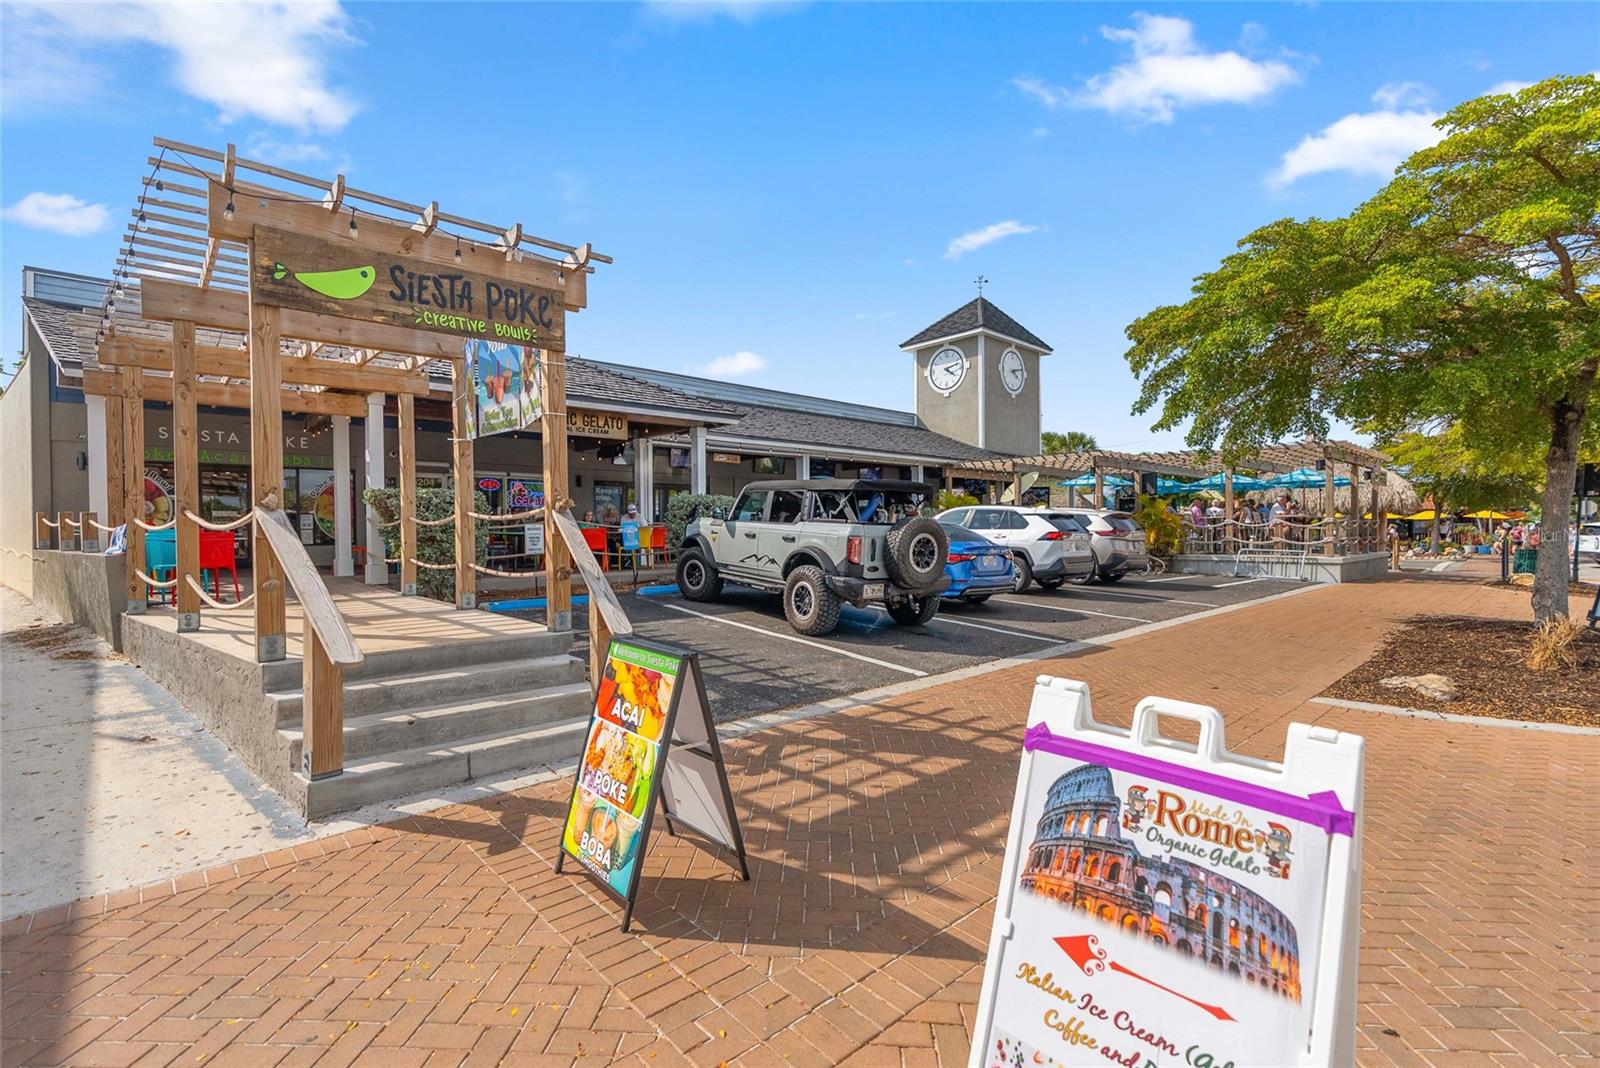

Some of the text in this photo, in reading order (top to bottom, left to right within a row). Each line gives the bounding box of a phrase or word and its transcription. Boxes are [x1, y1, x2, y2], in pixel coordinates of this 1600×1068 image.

[583, 415, 623, 431] GELATO
[158, 426, 310, 449] SSTA KE
[144, 448, 174, 461] oke
[284, 454, 312, 465] oba
[514, 495, 545, 506] GELAT
[611, 702, 645, 727] ACAI
[594, 771, 628, 805] POKE
[1153, 790, 1256, 854] Rome
[1187, 800, 1252, 828] Made In
[580, 831, 613, 870] BOBA
[1146, 827, 1260, 876] Organic Gelato
[582, 856, 612, 884] SMOOTHIES
[1015, 962, 1077, 1005] Italian
[1077, 993, 1109, 1021] Ice
[1113, 1010, 1180, 1057] Cream
[1043, 1008, 1142, 1068] Coffee and
